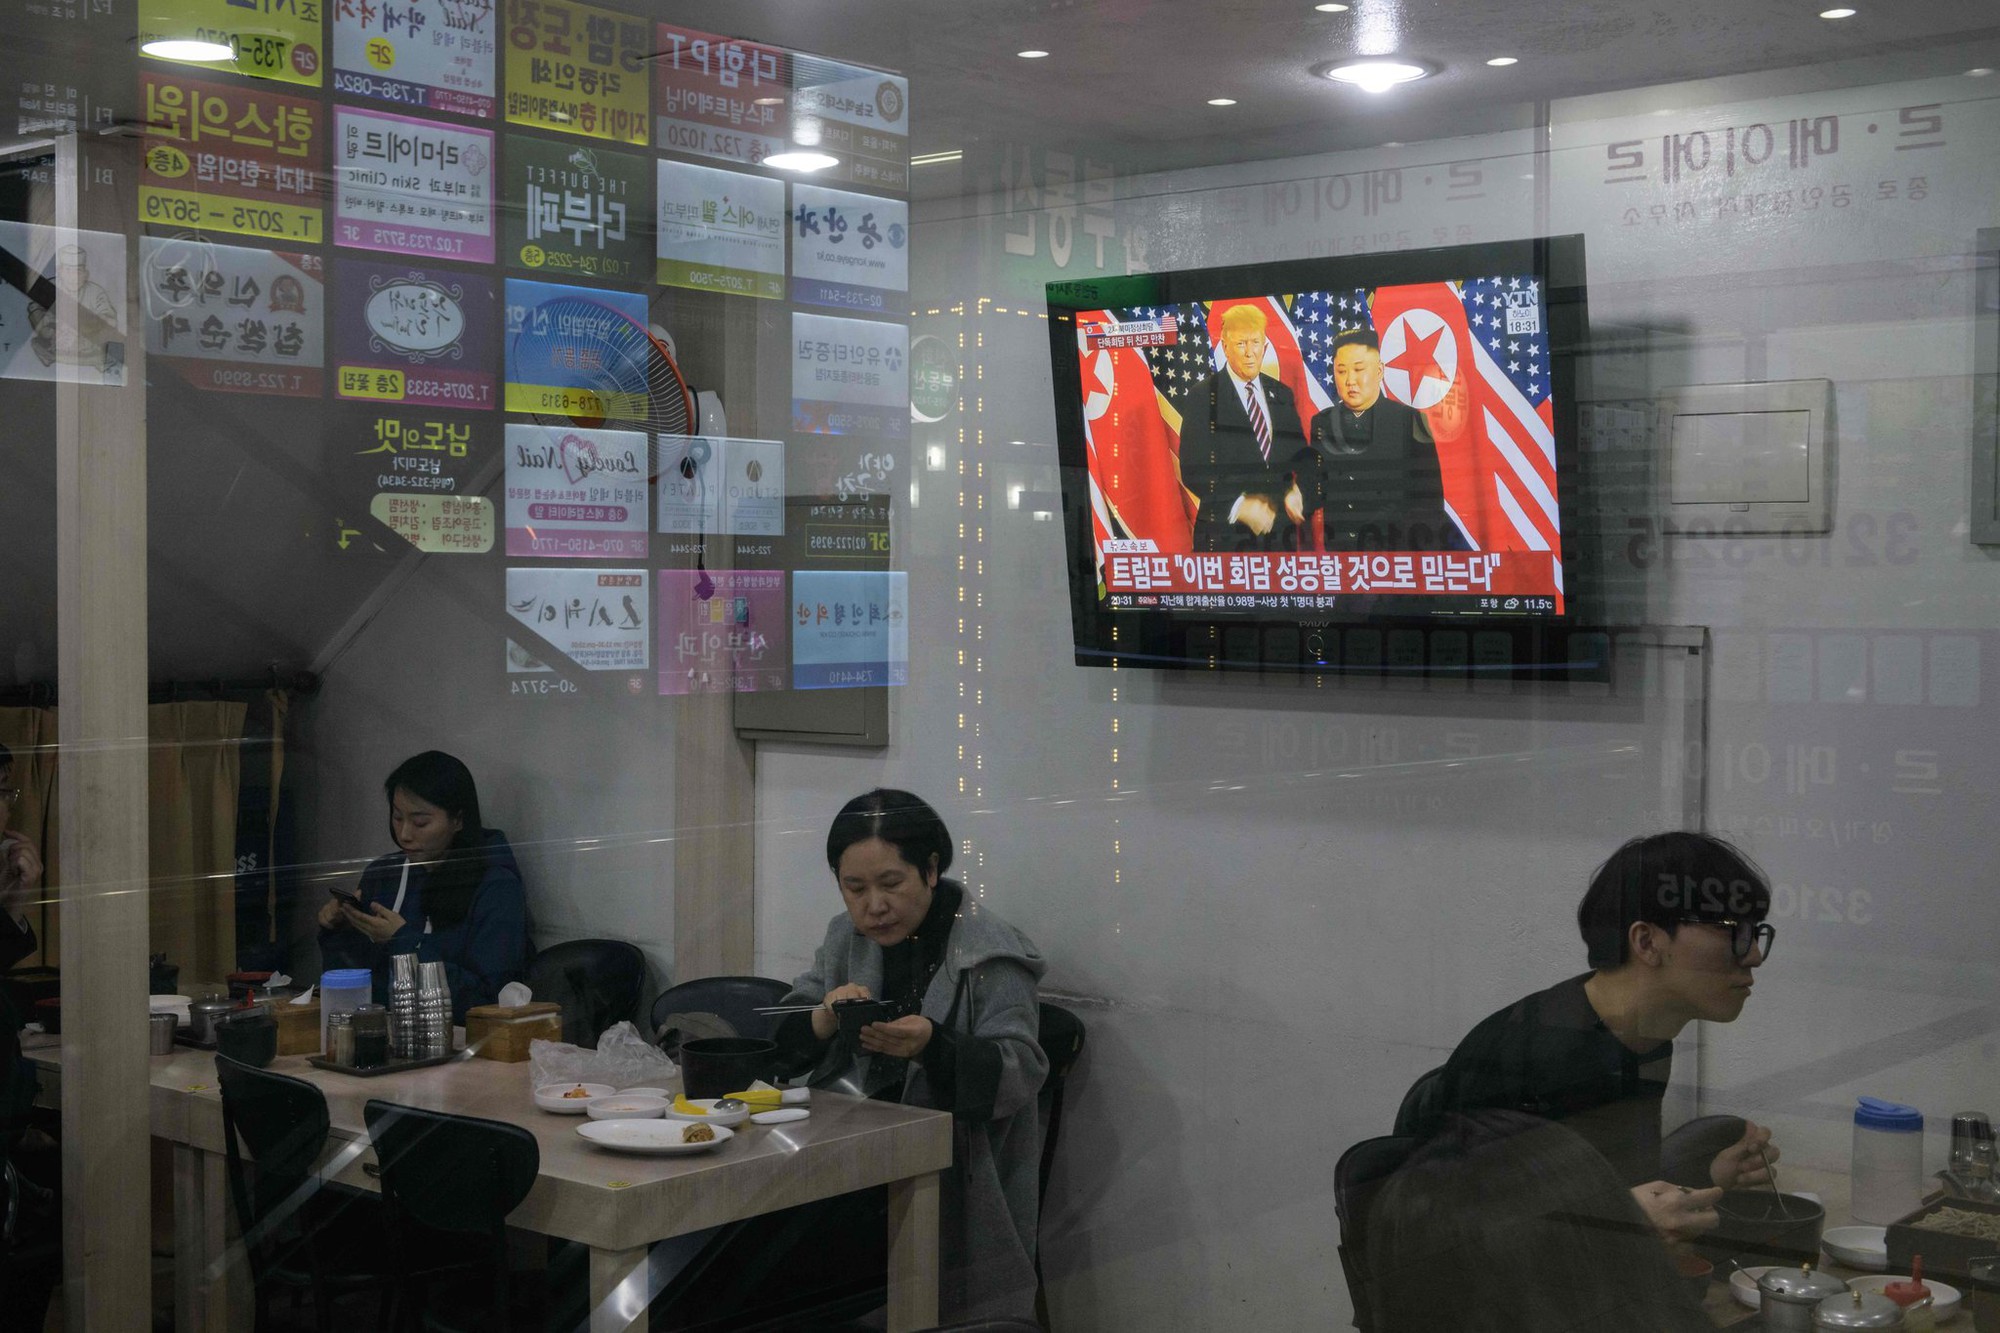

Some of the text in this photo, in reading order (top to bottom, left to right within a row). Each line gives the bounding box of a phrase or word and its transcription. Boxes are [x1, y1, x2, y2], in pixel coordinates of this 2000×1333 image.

[1509, 319, 1538, 333] 18:31
[1112, 553, 1501, 591] 트럼프 "이번 회담 성공할 것으로 믿는다"
